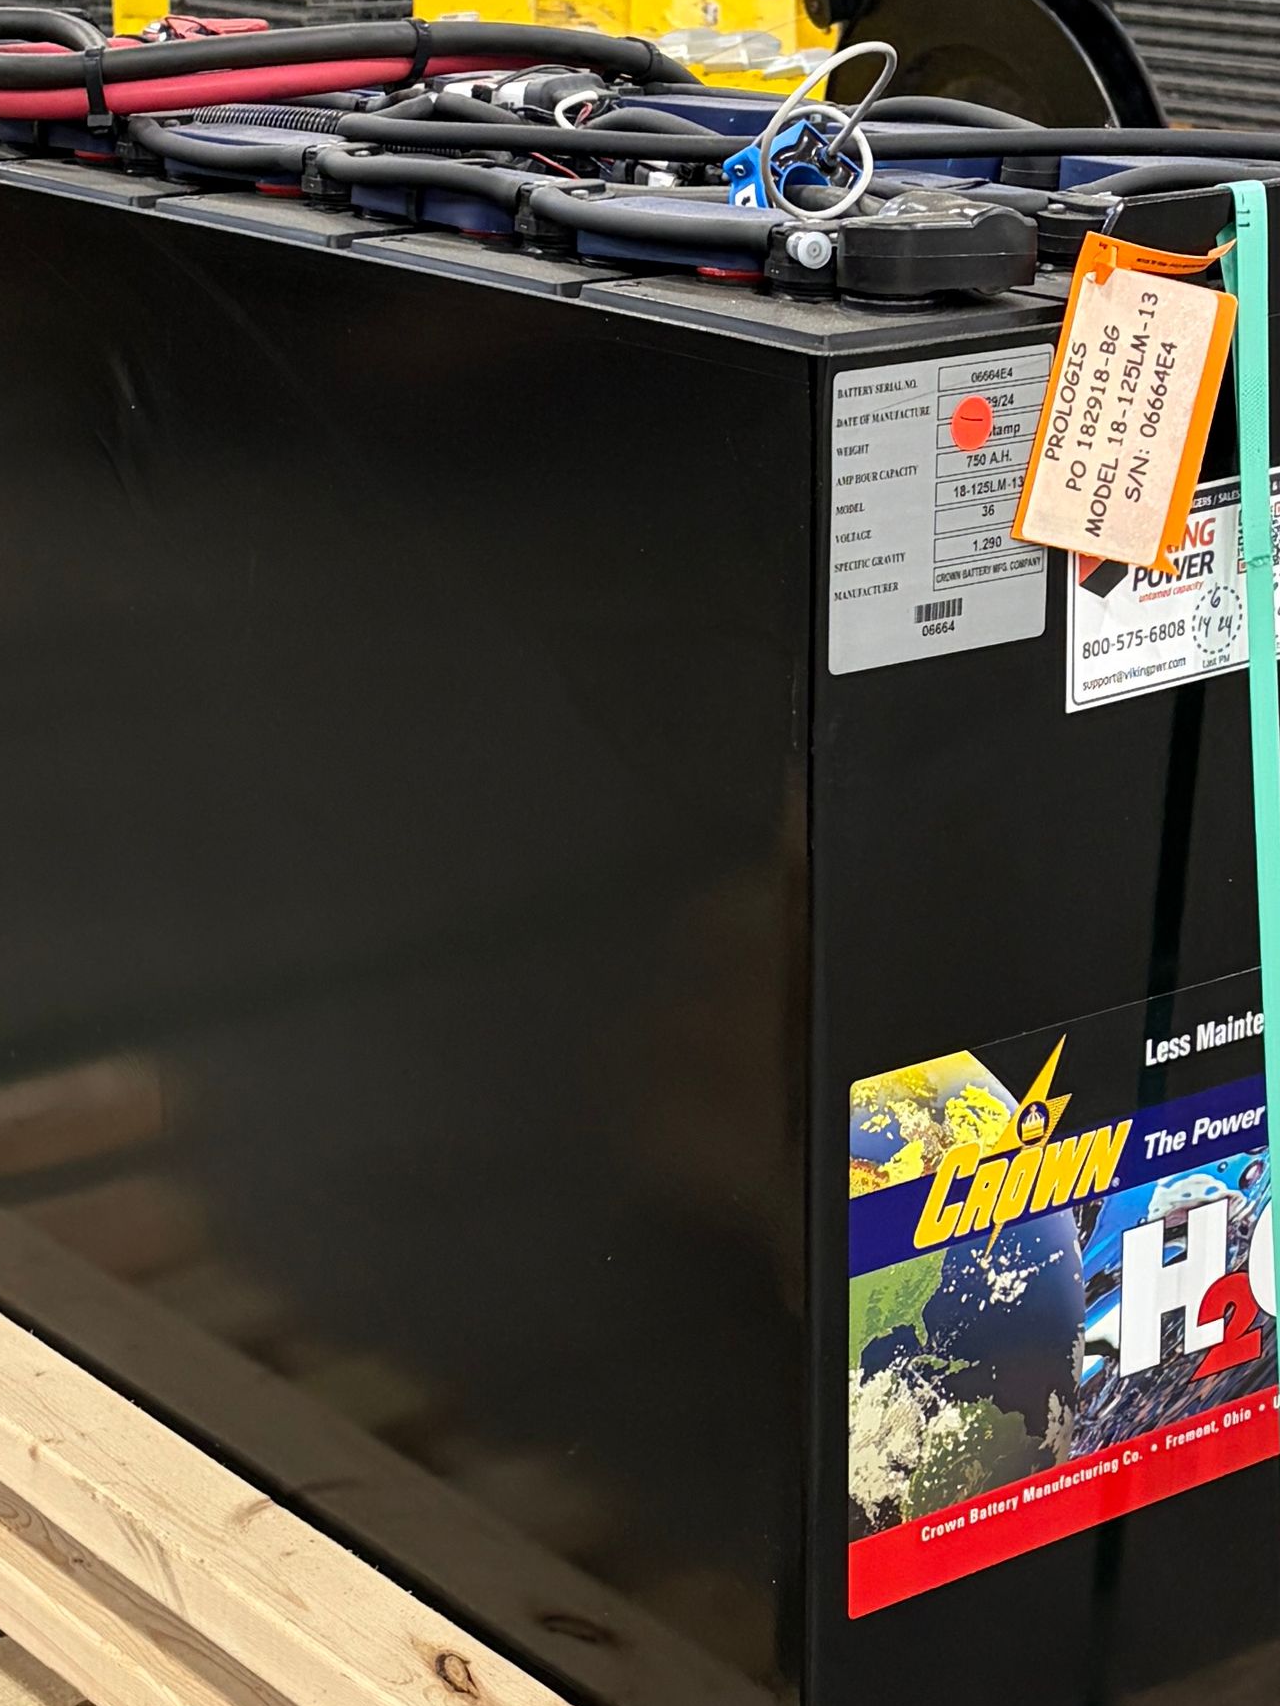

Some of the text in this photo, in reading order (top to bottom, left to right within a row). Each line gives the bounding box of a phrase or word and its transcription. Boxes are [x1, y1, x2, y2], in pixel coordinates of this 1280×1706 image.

[837, 385, 873, 399] BATTERY
[875, 381, 902, 393] SERIAL
[1044, 341, 1087, 462] PROLOGIS
[1065, 324, 1121, 492] PO 182918-BG
[836, 406, 930, 428] DATE OF MANUFACTURE
[1085, 291, 1159, 537] MODEL 18-125LM-13
[1125, 342, 1178, 503] S/N: 06664E4
[836, 443, 869, 457] WEIGHT
[967, 450, 1012, 468] 750 A.H.
[836, 476, 853, 486] AMP
[879, 465, 918, 480] CAPACITY
[954, 476, 1024, 497] 18-125LM-13
[836, 502, 865, 515] MODEL
[982, 504, 995, 517] 36
[835, 530, 872, 543] VOLTAGE
[973, 536, 1002, 551] 1.290
[834, 552, 906, 573] SPECIFIC GRAVITY
[936, 571, 961, 583] CROWN
[963, 566, 991, 579] BATTERY
[1010, 556, 1041, 571] COMPANY
[834, 582, 898, 601] MANUFACTURER
[1173, 580, 1204, 595] capacity
[922, 620, 955, 637] 06664
[1082, 619, 1186, 660] 800-575-6808
[1082, 656, 1186, 691] support@vikingpwr.com
[1144, 1034, 1191, 1067] Less
[1144, 1128, 1187, 1161] The
[1192, 1104, 1266, 1146] Power
[921, 1516, 965, 1542] Crown
[970, 1494, 1019, 1524] Battery
[1022, 1458, 1119, 1504] Manufacturing
[1123, 1449, 1143, 1466] Co.
[1165, 1419, 1220, 1450] Fremont,
[1223, 1408, 1252, 1429] Ohio
